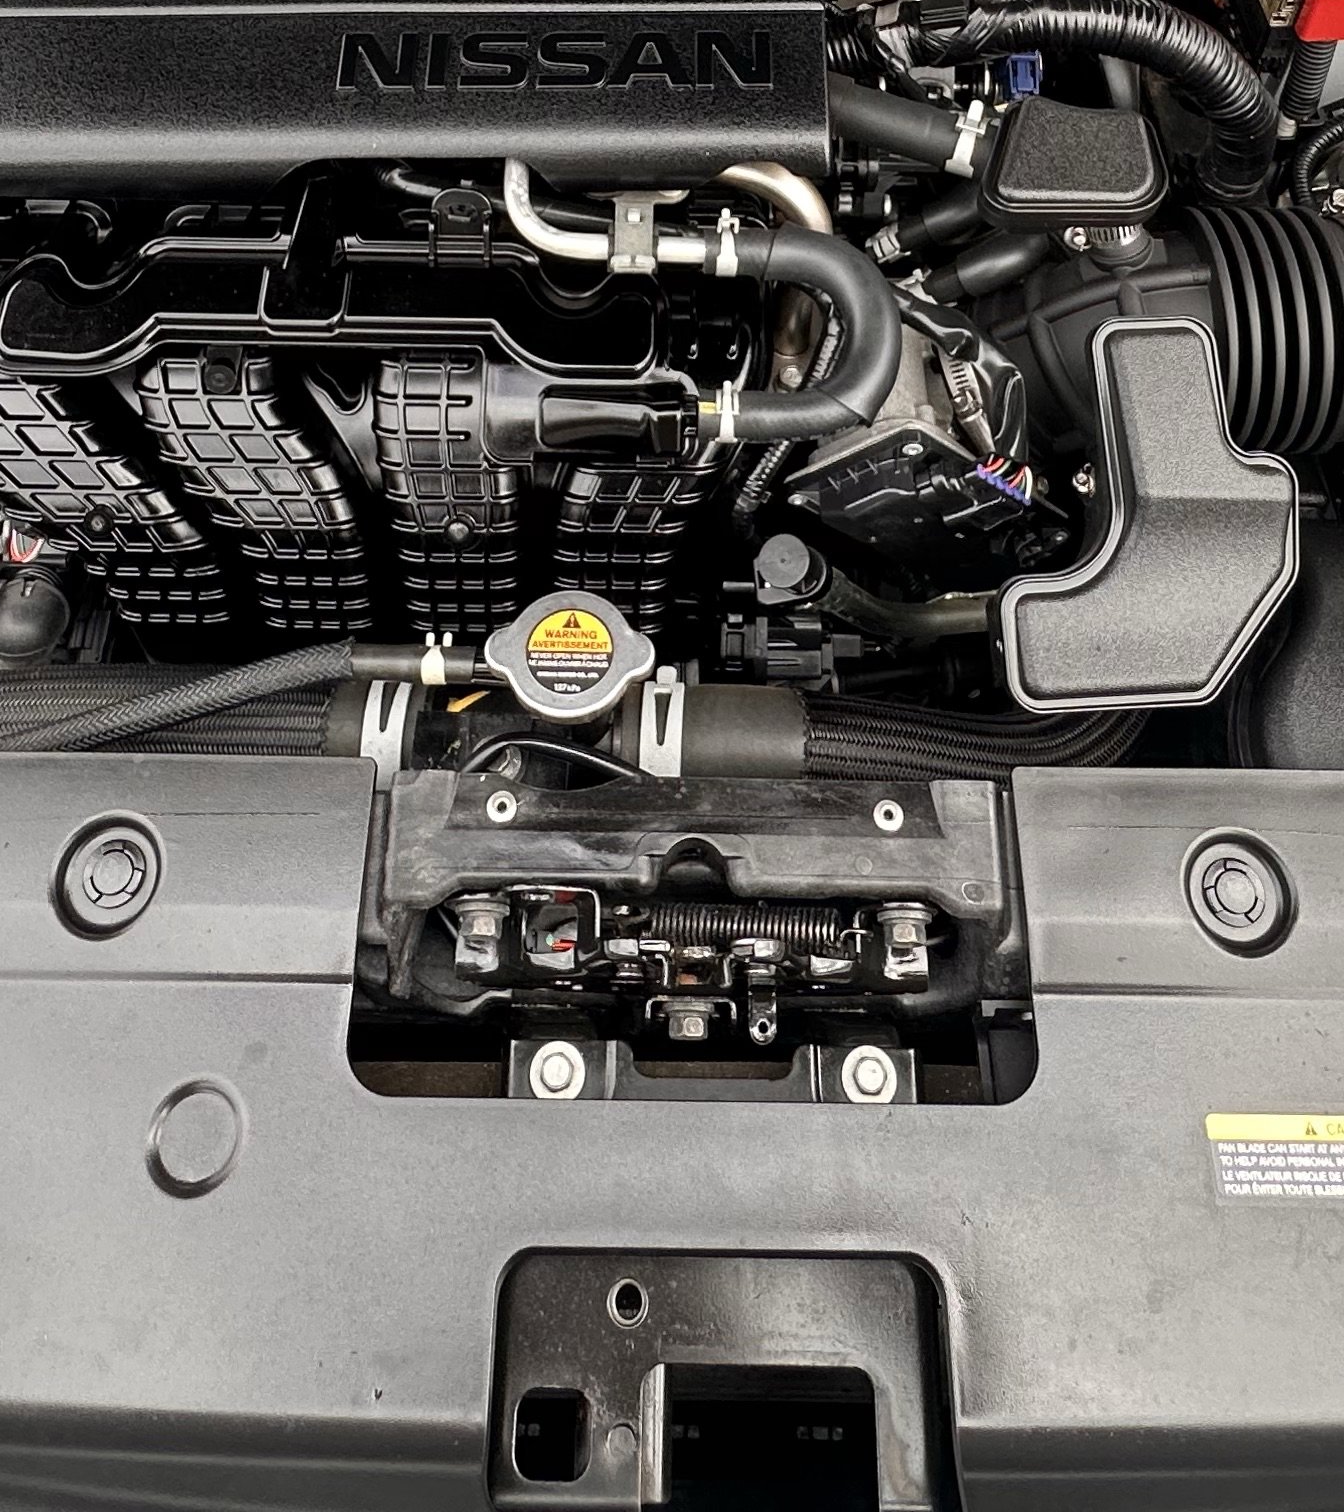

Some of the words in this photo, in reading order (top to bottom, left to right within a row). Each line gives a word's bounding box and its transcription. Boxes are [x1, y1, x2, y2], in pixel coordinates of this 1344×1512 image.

[335, 30, 774, 91] NISSAN
[545, 629, 598, 640] WARNING
[532, 640, 608, 650] AVERTISSEMENT
[1236, 1142, 1266, 1153] BLADE
[1266, 1143, 1288, 1153] CAN
[1316, 1143, 1328, 1153] AT
[1219, 1155, 1233, 1165] TO
[1233, 1155, 1257, 1165] HELP
[1258, 1155, 1286, 1166] AVOID
[1286, 1156, 1335, 1166] PERSONAL
[1221, 1170, 1234, 1180] LE
[1234, 1170, 1292, 1181] VENTILATEUR
[1328, 1171, 1341, 1181] DE
[1224, 1183, 1251, 1194] POUR
[1283, 1184, 1313, 1195] TOUTE
